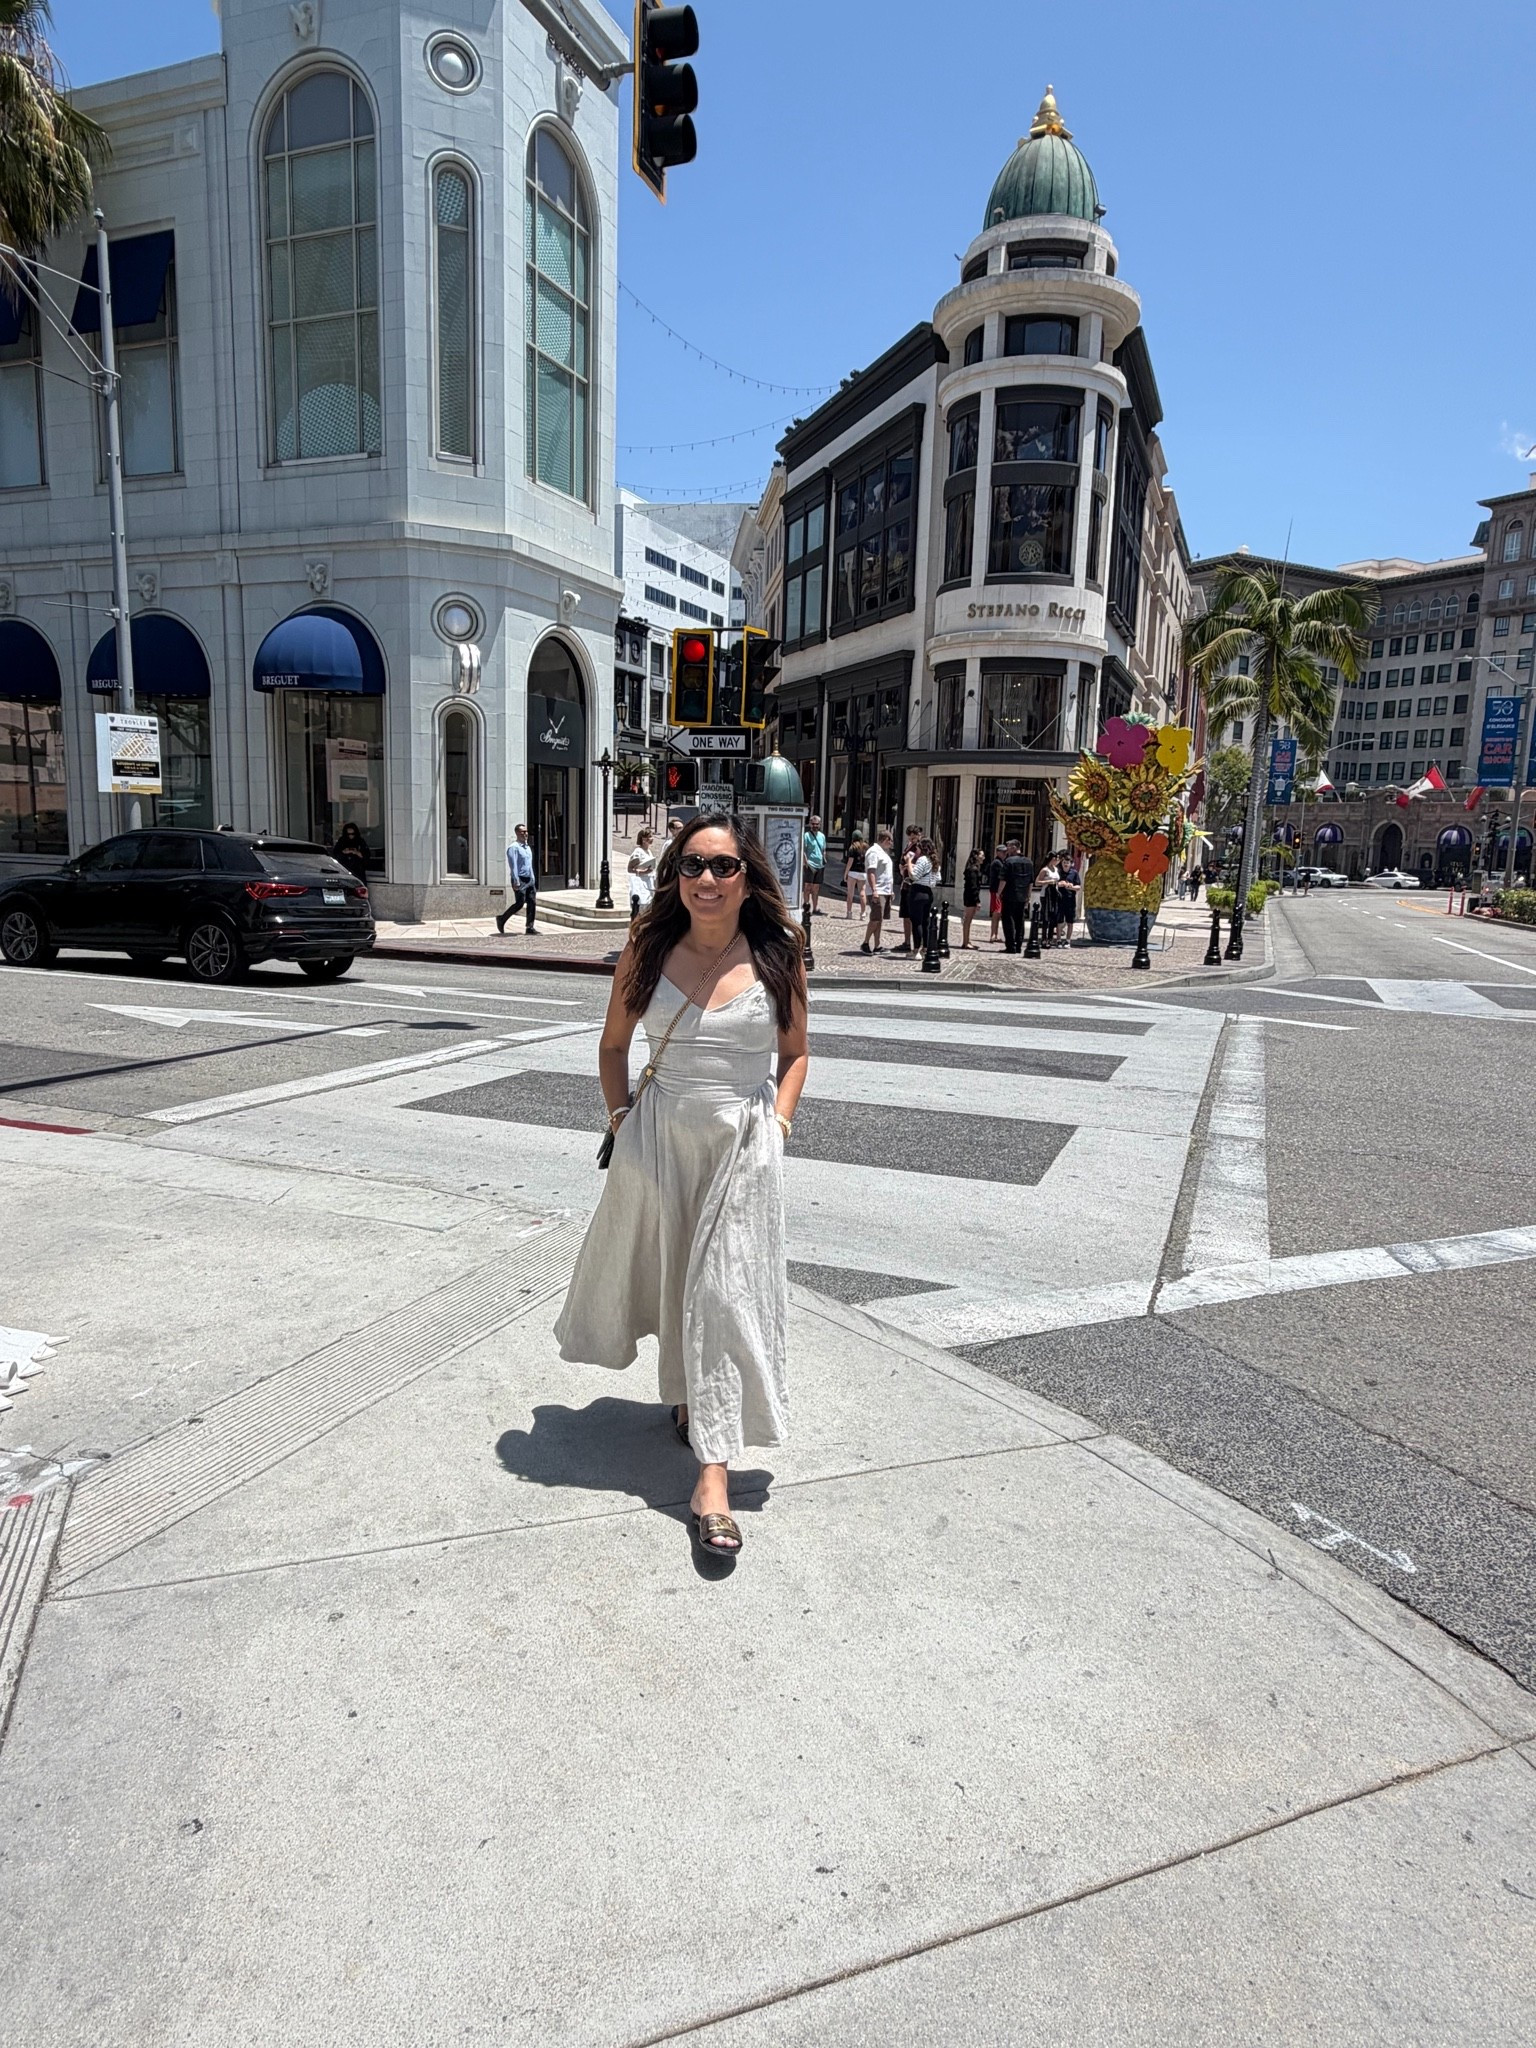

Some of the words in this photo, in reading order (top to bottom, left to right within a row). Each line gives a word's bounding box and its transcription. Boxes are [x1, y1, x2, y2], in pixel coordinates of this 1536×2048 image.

[967, 603, 1040, 618] STEFANO
[1048, 602, 1086, 621] RICCI
[91, 679, 119, 689] BREGUE
[261, 675, 300, 685] BREGUET
[692, 736, 714, 748] ONE
[718, 736, 740, 748] WAY
[1484, 742, 1513, 755] CAR
[1482, 755, 1512, 764] SHOW
[701, 803, 712, 813] OK
